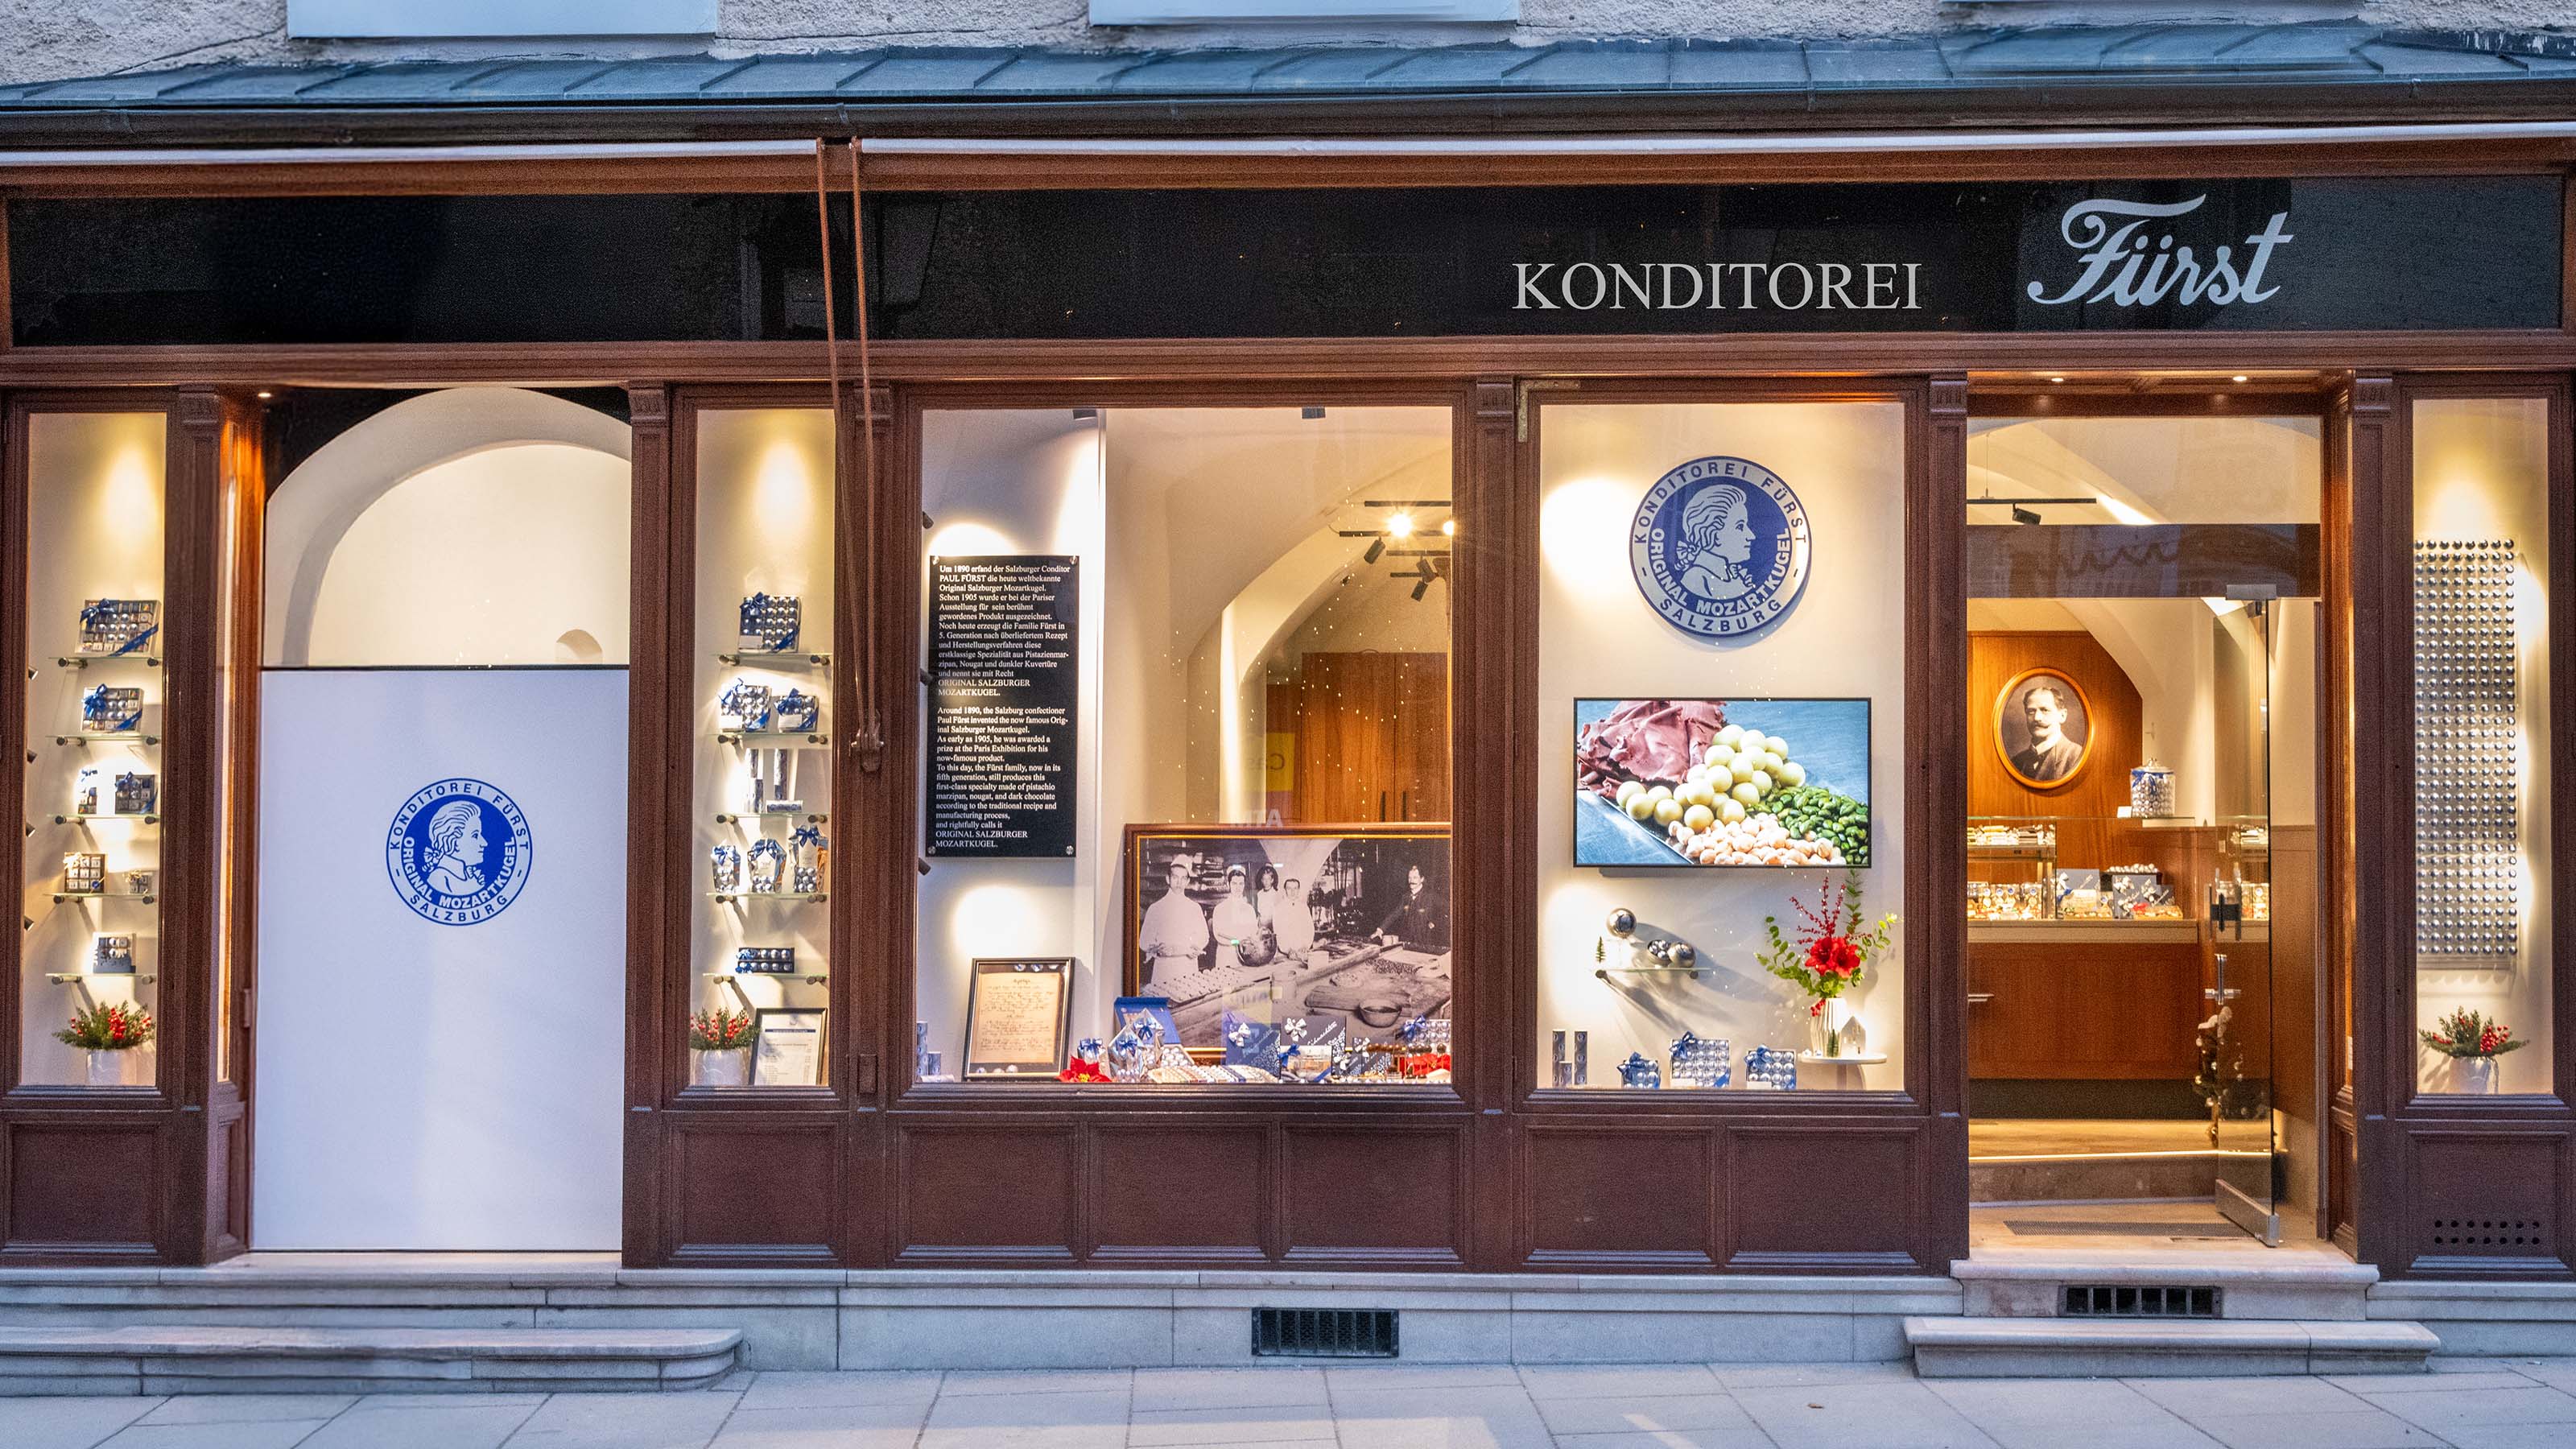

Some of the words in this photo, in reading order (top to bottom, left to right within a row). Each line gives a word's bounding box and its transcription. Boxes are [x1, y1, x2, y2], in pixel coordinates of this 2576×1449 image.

[1512, 262, 1922, 309] KONDITOREI
[2026, 193, 2293, 306] Fürst
[1635, 462, 1747, 543] KONDITOREI
[1761, 477, 1806, 543] FÜRST
[939, 565, 952, 573] Um
[955, 565, 969, 573] 1890
[971, 565, 992, 573] erfand
[993, 565, 1004, 573] der
[1005, 565, 1040, 574] Salzburger
[1042, 565, 1070, 573] Conditor
[1650, 528, 1688, 605] ORIGINAL
[1696, 528, 1790, 616] MOZARTKUGEL
[961, 574, 985, 582] FÜRST
[939, 584, 966, 593] Original
[968, 584, 1002, 593] Salzburger
[1004, 584, 1046, 593] Mozartkugel.
[939, 593, 960, 601] Schon
[962, 593, 976, 601] 1905
[979, 593, 998, 601] wurde
[1009, 593, 1018, 601] bei
[1020, 593, 1030, 601] der
[1032, 593, 1055, 601] Pariser
[939, 603, 977, 612] Ausstellung
[939, 613, 977, 621] gewordenes
[1005, 613, 1052, 621] ausgezeichnet.
[1660, 599, 1781, 631] SALZBURG
[977, 622, 1001, 631] erzeugt
[947, 631, 982, 639] Generation
[984, 631, 999, 639] nach
[1001, 631, 1043, 639] überliefertem
[1045, 631, 1067, 640] Rezept
[953, 641, 1022, 650] Herstellungsverfahren
[939, 650, 976, 659] erstklassige
[977, 650, 1011, 659] Spezialität
[939, 660, 958, 669] zipan,
[960, 660, 983, 669] Nougat
[939, 669, 950, 677] und
[952, 669, 970, 677] nennt
[972, 669, 980, 677] sie
[982, 669, 993, 677] mit
[995, 669, 1013, 677] Recht
[964, 707, 981, 715] 1890,
[995, 707, 1023, 716] Salzburg
[1051, 716, 1067, 725] Orig-
[938, 725, 949, 733] inal
[951, 725, 985, 734] Salzburger
[987, 725, 1030, 734] Mozartkugel.
[937, 735, 946, 743] As
[947, 735, 964, 744] early
[975, 735, 992, 744] 1905,
[993, 735, 1001, 743] he
[1018, 735, 1045, 743] awarded
[937, 745, 953, 753] prize
[978, 754, 1005, 763] product.
[960, 764, 973, 773] day,
[1005, 764, 1027, 773] family,
[937, 773, 950, 781] fifth
[952, 773, 987, 782] generation,
[989, 773, 1001, 781] still
[1002, 773, 1031, 782] produces
[1033, 773, 1045, 781] this
[937, 782, 967, 791] first-class
[968, 782, 997, 791] specialty
[998, 782, 1016, 791] made
[1018, 782, 1024, 791] of
[1026, 782, 1055, 791] pistachio
[936, 792, 968, 801] marzipan,
[969, 792, 993, 801] nougat,
[936, 802, 968, 811] according
[1023, 802, 1043, 811] recipe
[390, 782, 481, 849] KONDITOREI
[493, 795, 528, 849] FÜRST
[936, 811, 982, 820] manufacturing
[936, 820, 947, 828] and
[949, 820, 979, 829] rightfully
[980, 820, 996, 828] calls
[997, 820, 1001, 828] it
[935, 830, 974, 838] ORIGINAL
[976, 830, 1027, 838] SALZBURGER
[403, 836, 433, 900] ORIGINAL
[439, 837, 515, 909] MOZARTKUGEL
[410, 894, 508, 922] SALZBURG
